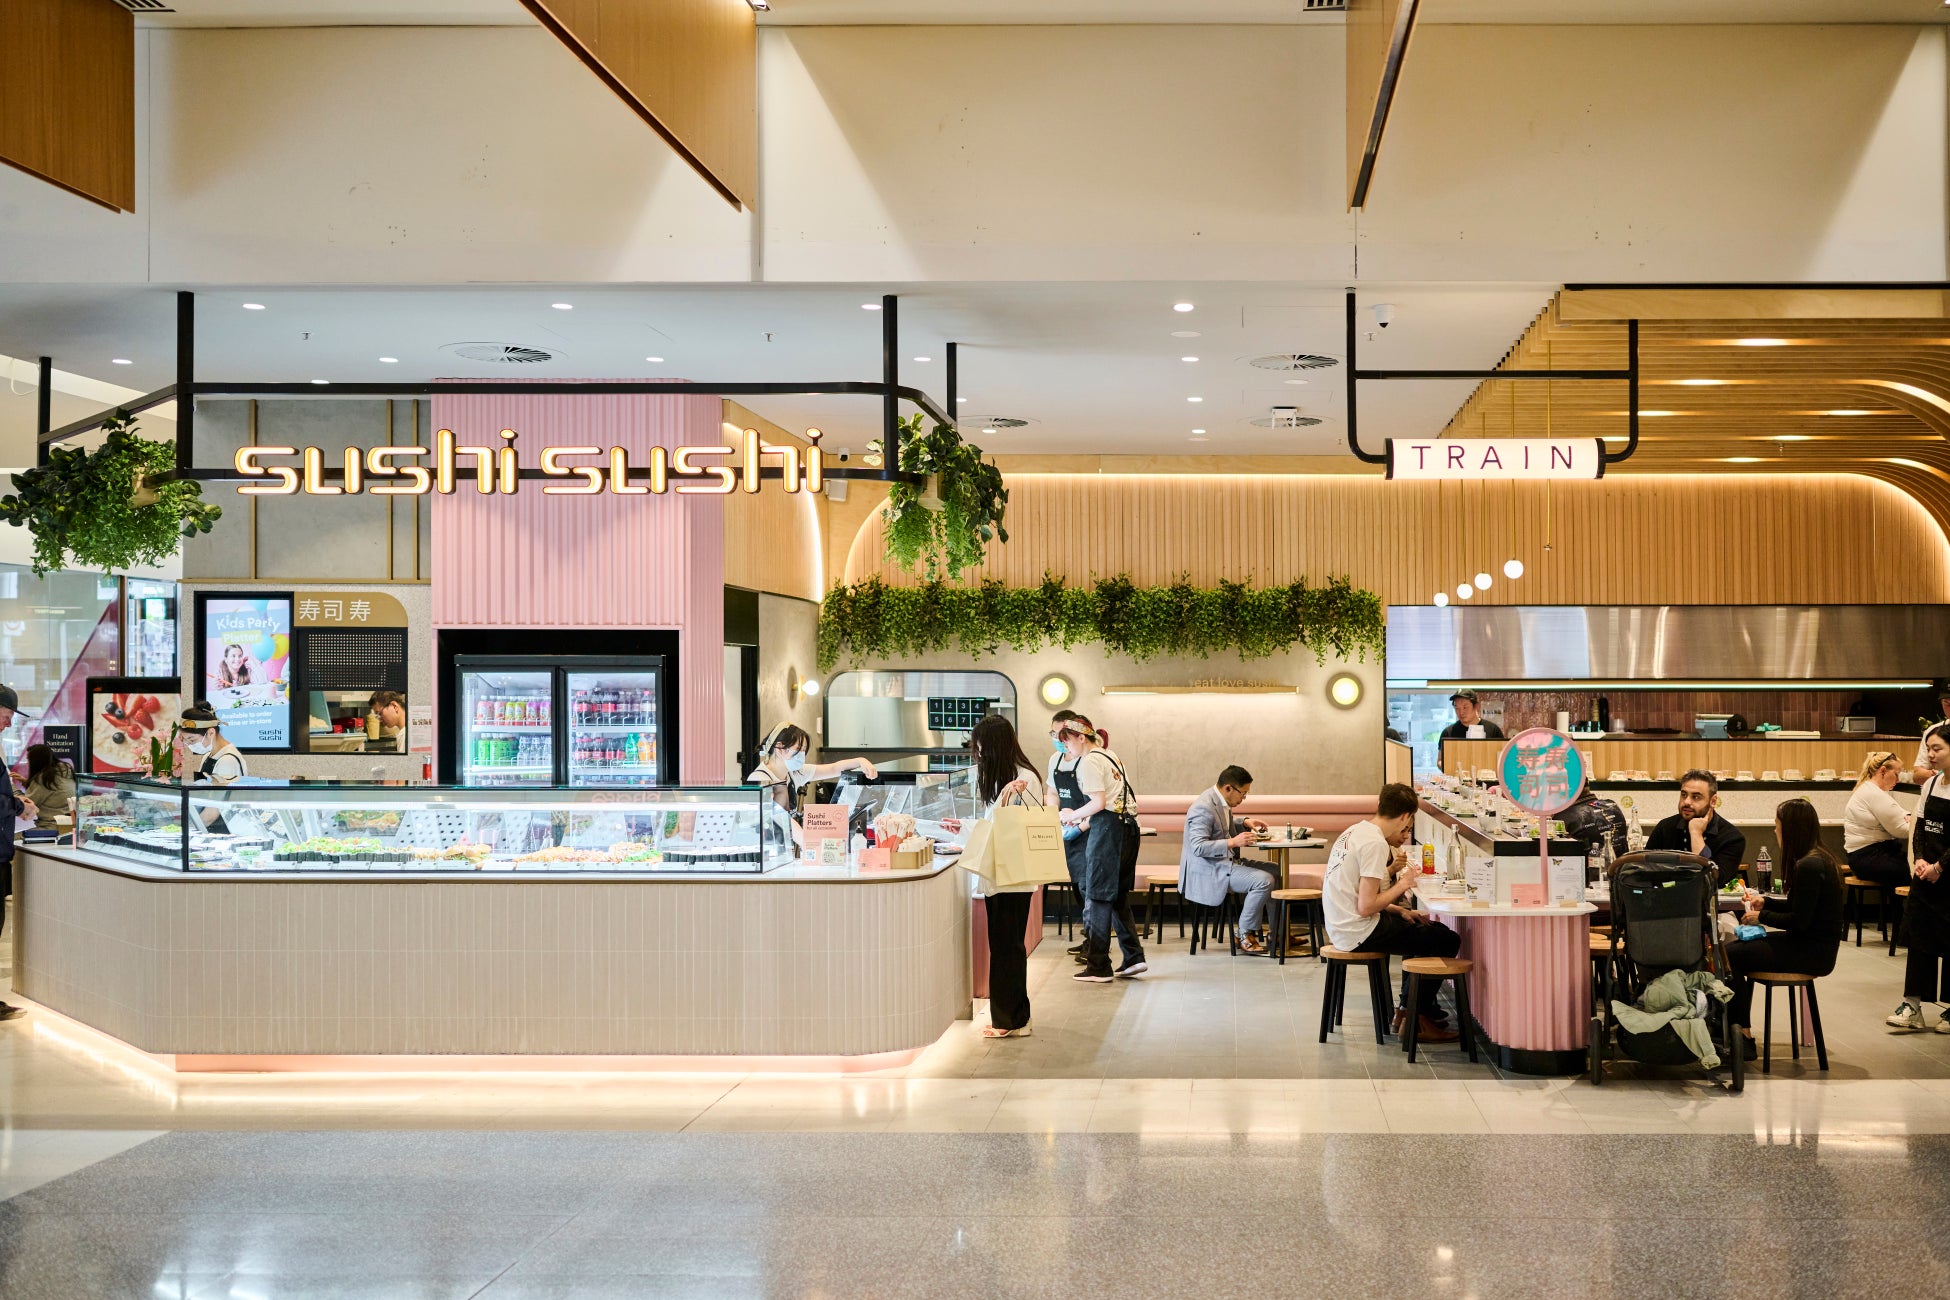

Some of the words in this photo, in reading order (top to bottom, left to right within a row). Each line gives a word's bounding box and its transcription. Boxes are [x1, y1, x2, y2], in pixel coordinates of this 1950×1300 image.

[234, 427, 518, 496] sushi
[540, 427, 824, 496] sushi
[1411, 445, 1573, 470] TRAIN
[216, 614, 245, 630] Kids
[247, 616, 281, 632] Party
[222, 632, 260, 643] Platter
[1194, 678, 1213, 687] eat
[1218, 677, 1244, 687] love
[807, 812, 826, 820] Sushi
